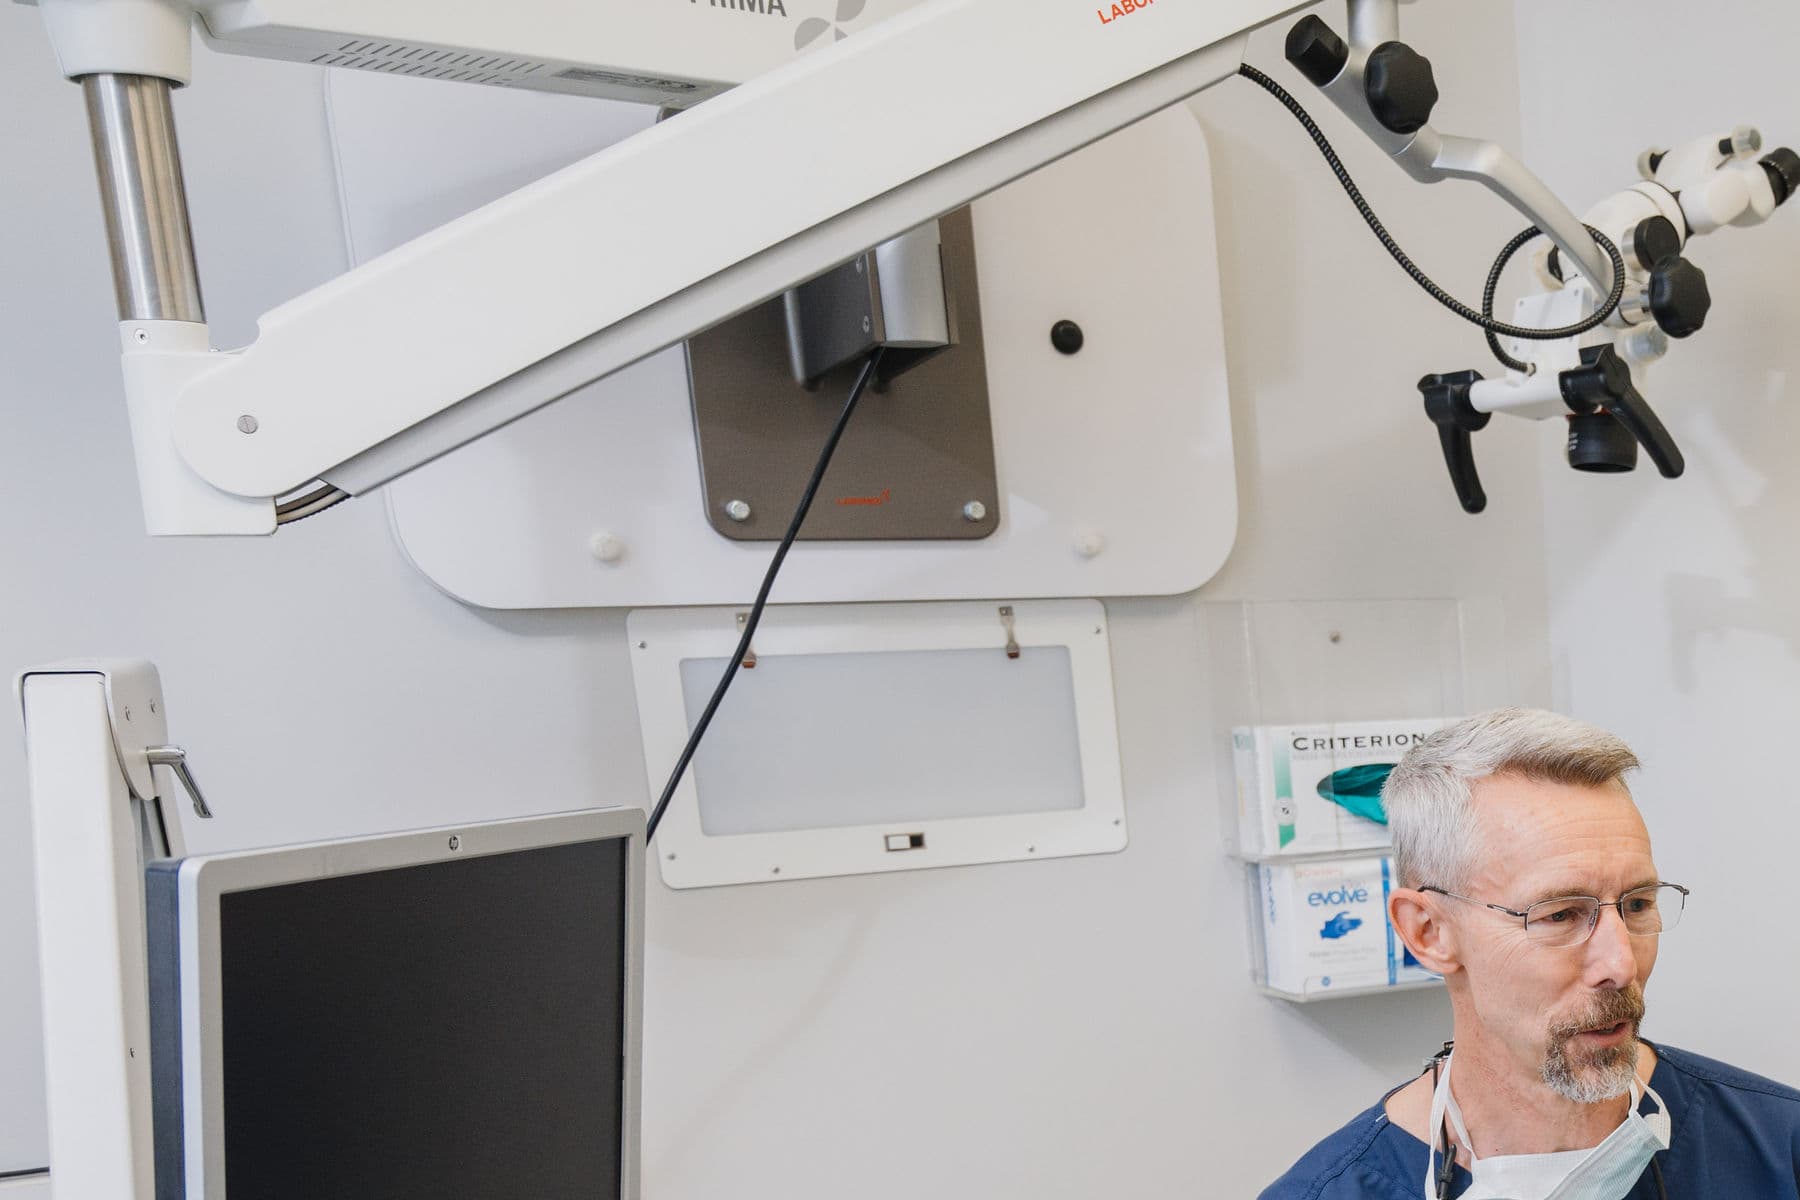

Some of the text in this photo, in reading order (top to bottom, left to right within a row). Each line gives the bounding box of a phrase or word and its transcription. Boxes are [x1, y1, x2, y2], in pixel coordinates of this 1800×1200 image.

[1097, 0, 1153, 24] LABO
[1292, 733, 1425, 751] CRITERION
[1307, 884, 1369, 907] evolve
